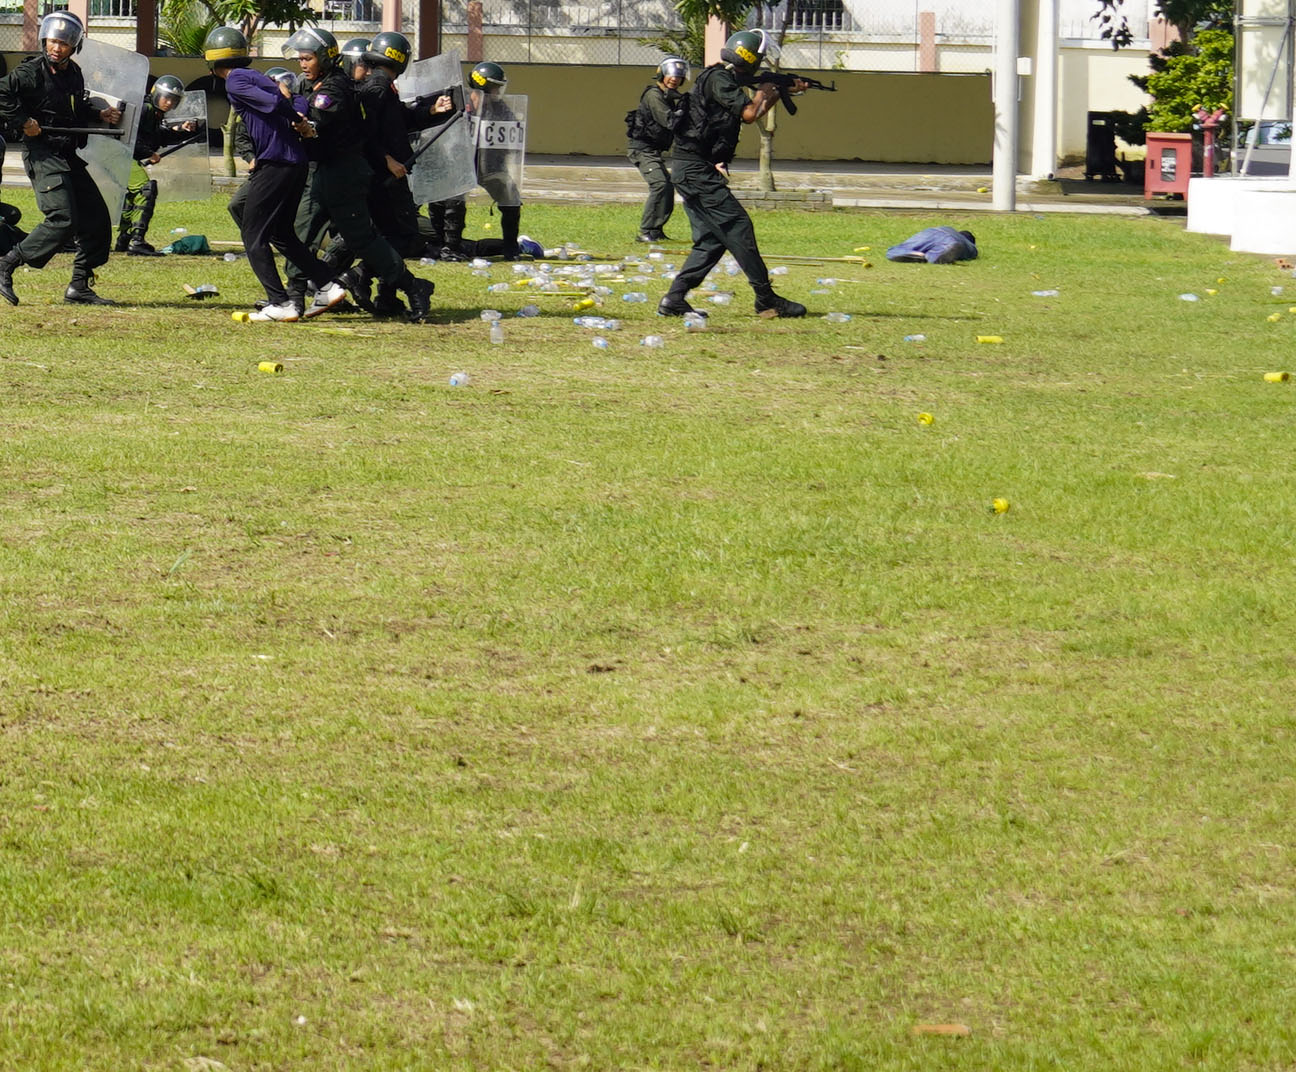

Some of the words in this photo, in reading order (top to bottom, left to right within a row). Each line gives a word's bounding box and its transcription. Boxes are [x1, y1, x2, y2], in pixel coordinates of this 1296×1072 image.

[384, 46, 406, 63] CSCD
[735, 45, 757, 64] CSCD
[485, 125, 524, 143] CSCD
